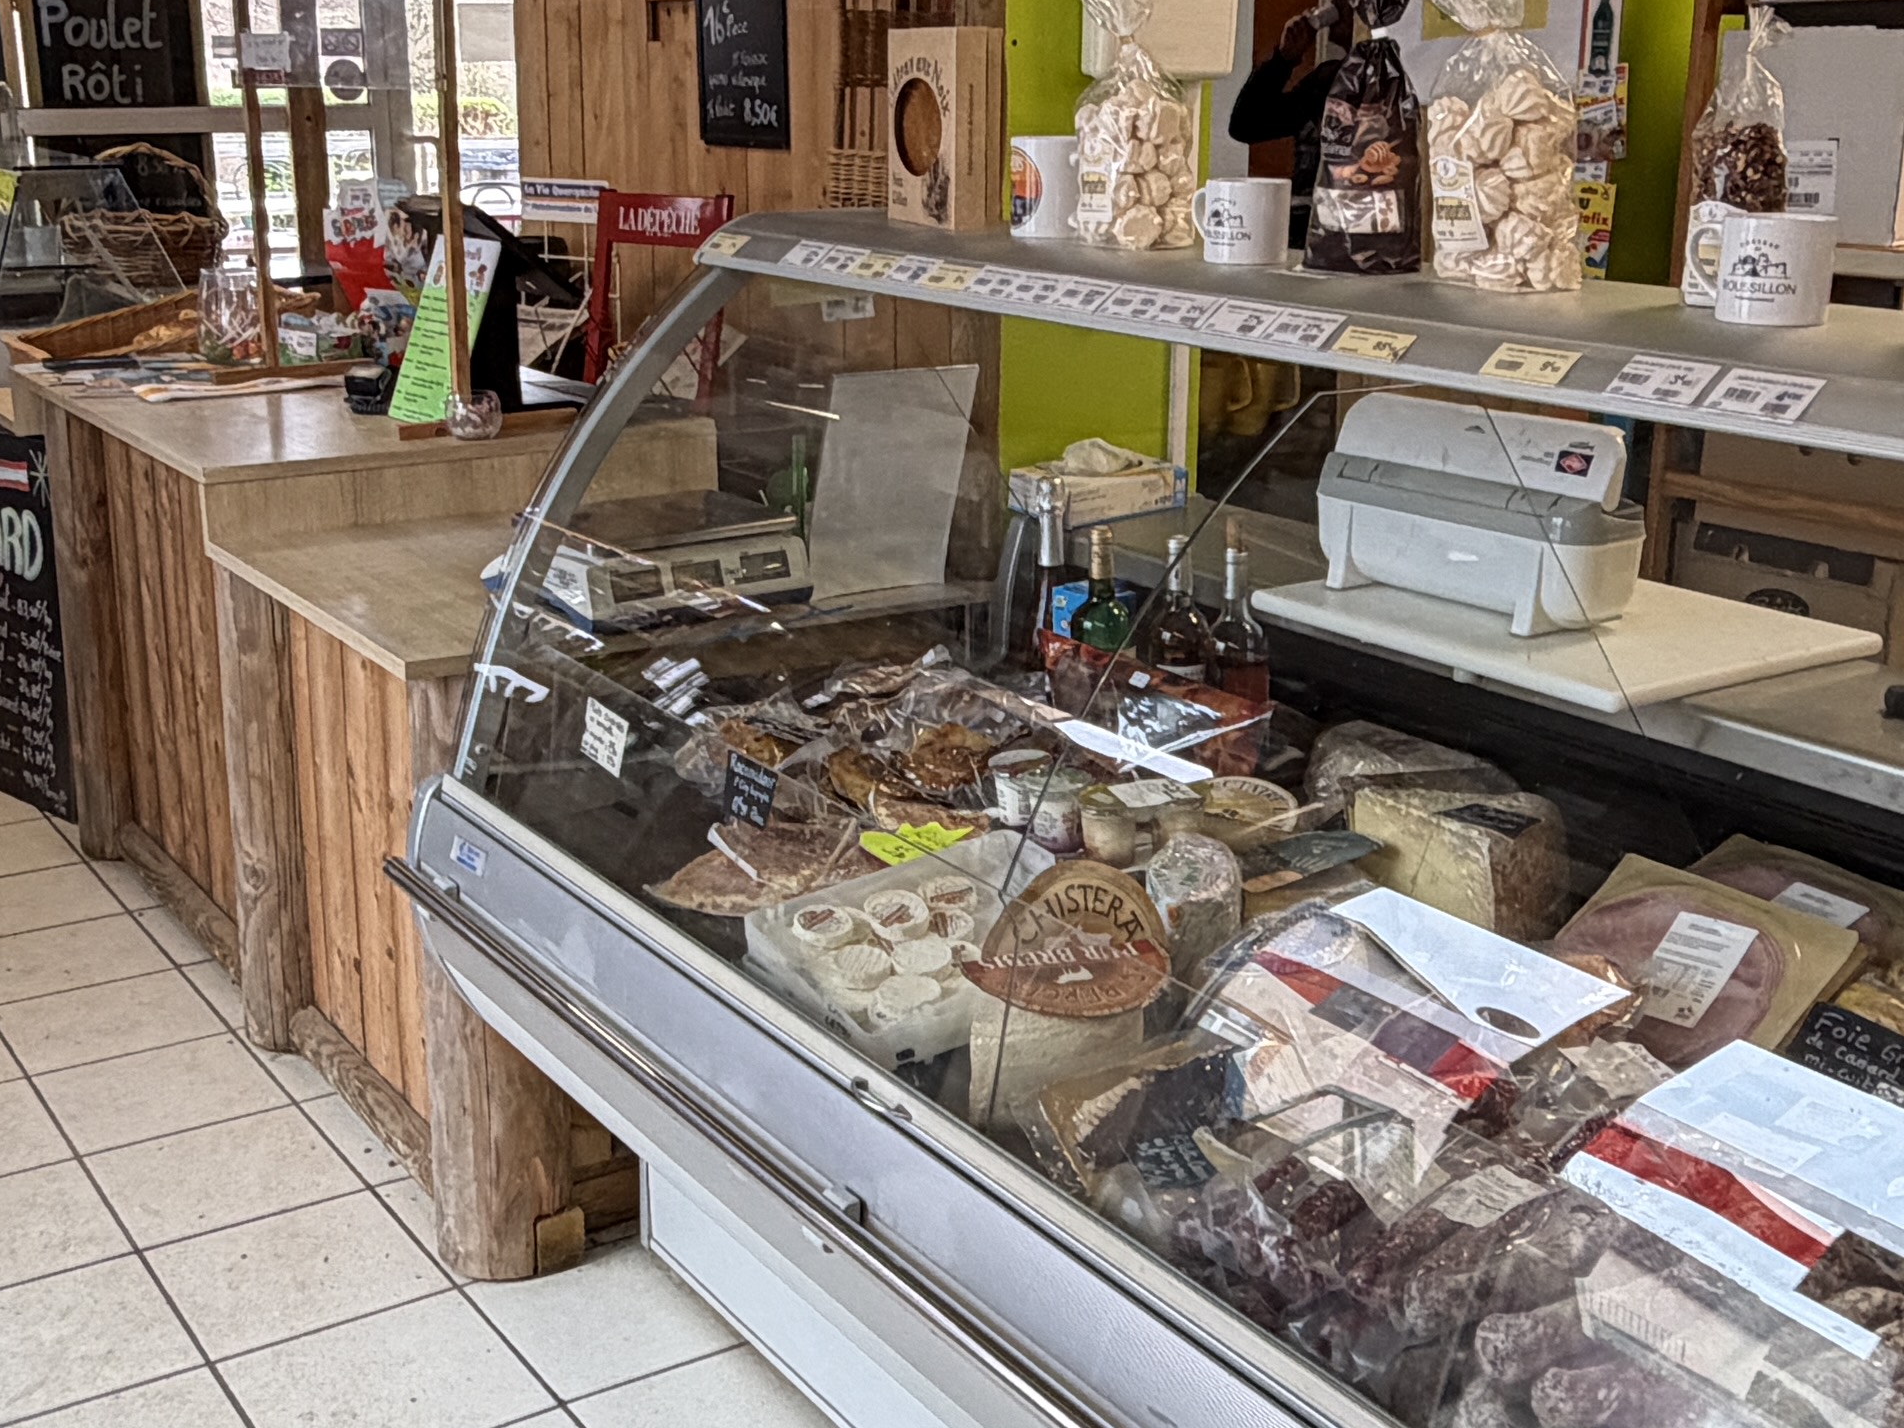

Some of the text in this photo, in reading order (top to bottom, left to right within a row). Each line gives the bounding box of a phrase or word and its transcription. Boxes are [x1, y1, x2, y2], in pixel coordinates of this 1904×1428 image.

[61, 60, 145, 104] Rôti
[1722, 278, 1797, 295] ROUSSILLON
[1021, 883, 1145, 945] CHISTERA
[1813, 1011, 1872, 1052] Foie
[1834, 1045, 1901, 1087] Canard
